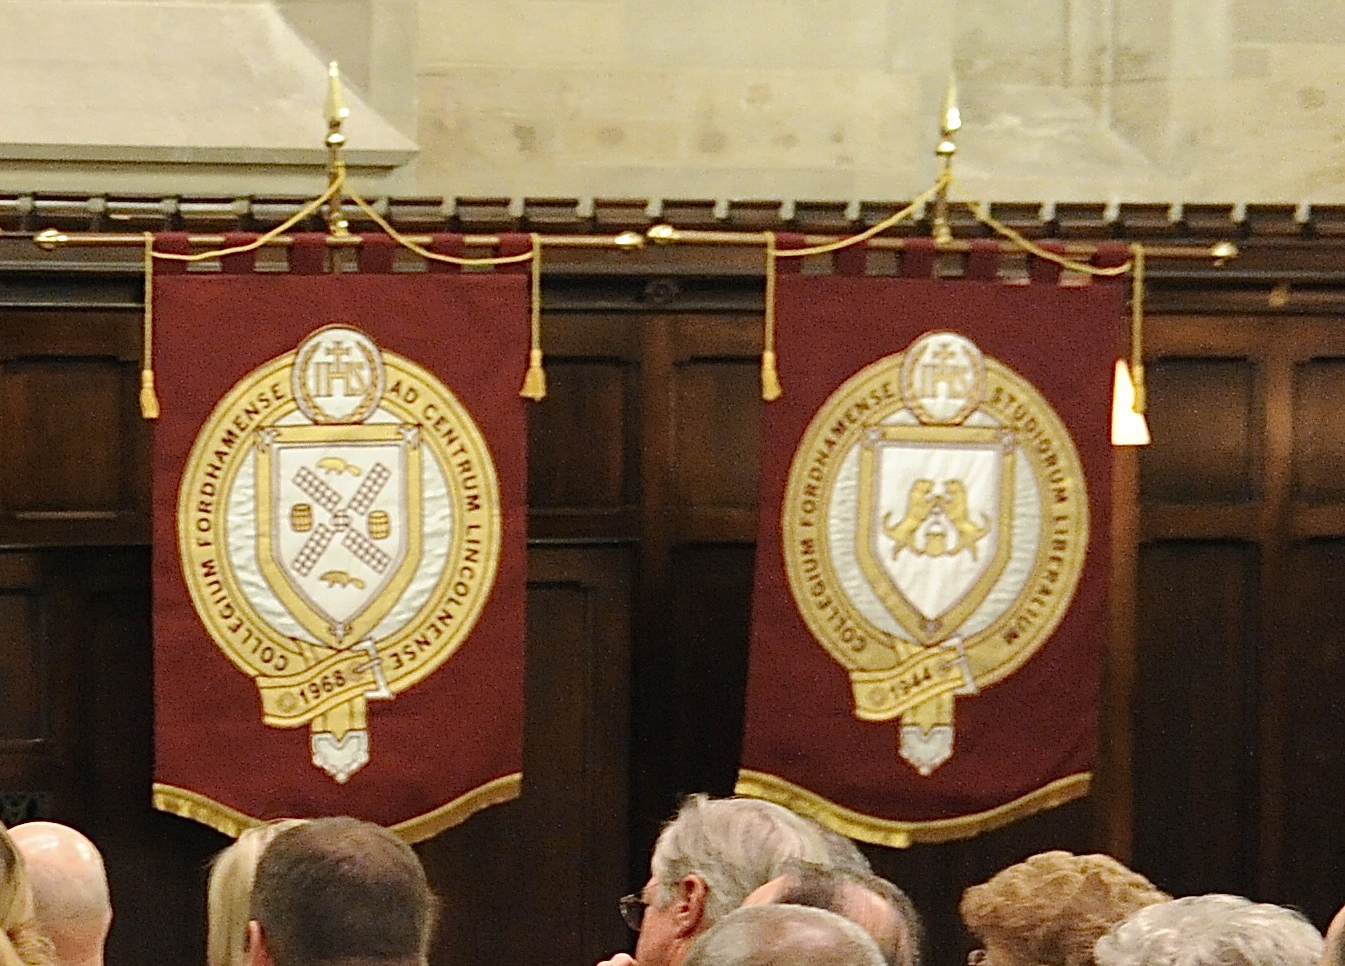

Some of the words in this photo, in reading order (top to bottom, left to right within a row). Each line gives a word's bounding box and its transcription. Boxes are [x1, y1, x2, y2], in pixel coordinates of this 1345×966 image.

[388, 381, 418, 405] AD
[197, 382, 284, 548] FORDHAMENSE
[423, 404, 481, 513] CENTRUM
[200, 560, 289, 672] COLLEGIUM
[390, 524, 481, 669] LINCOLNENSE
[799, 539, 868, 652] COLLEGIUM
[298, 669, 346, 705] 1968
